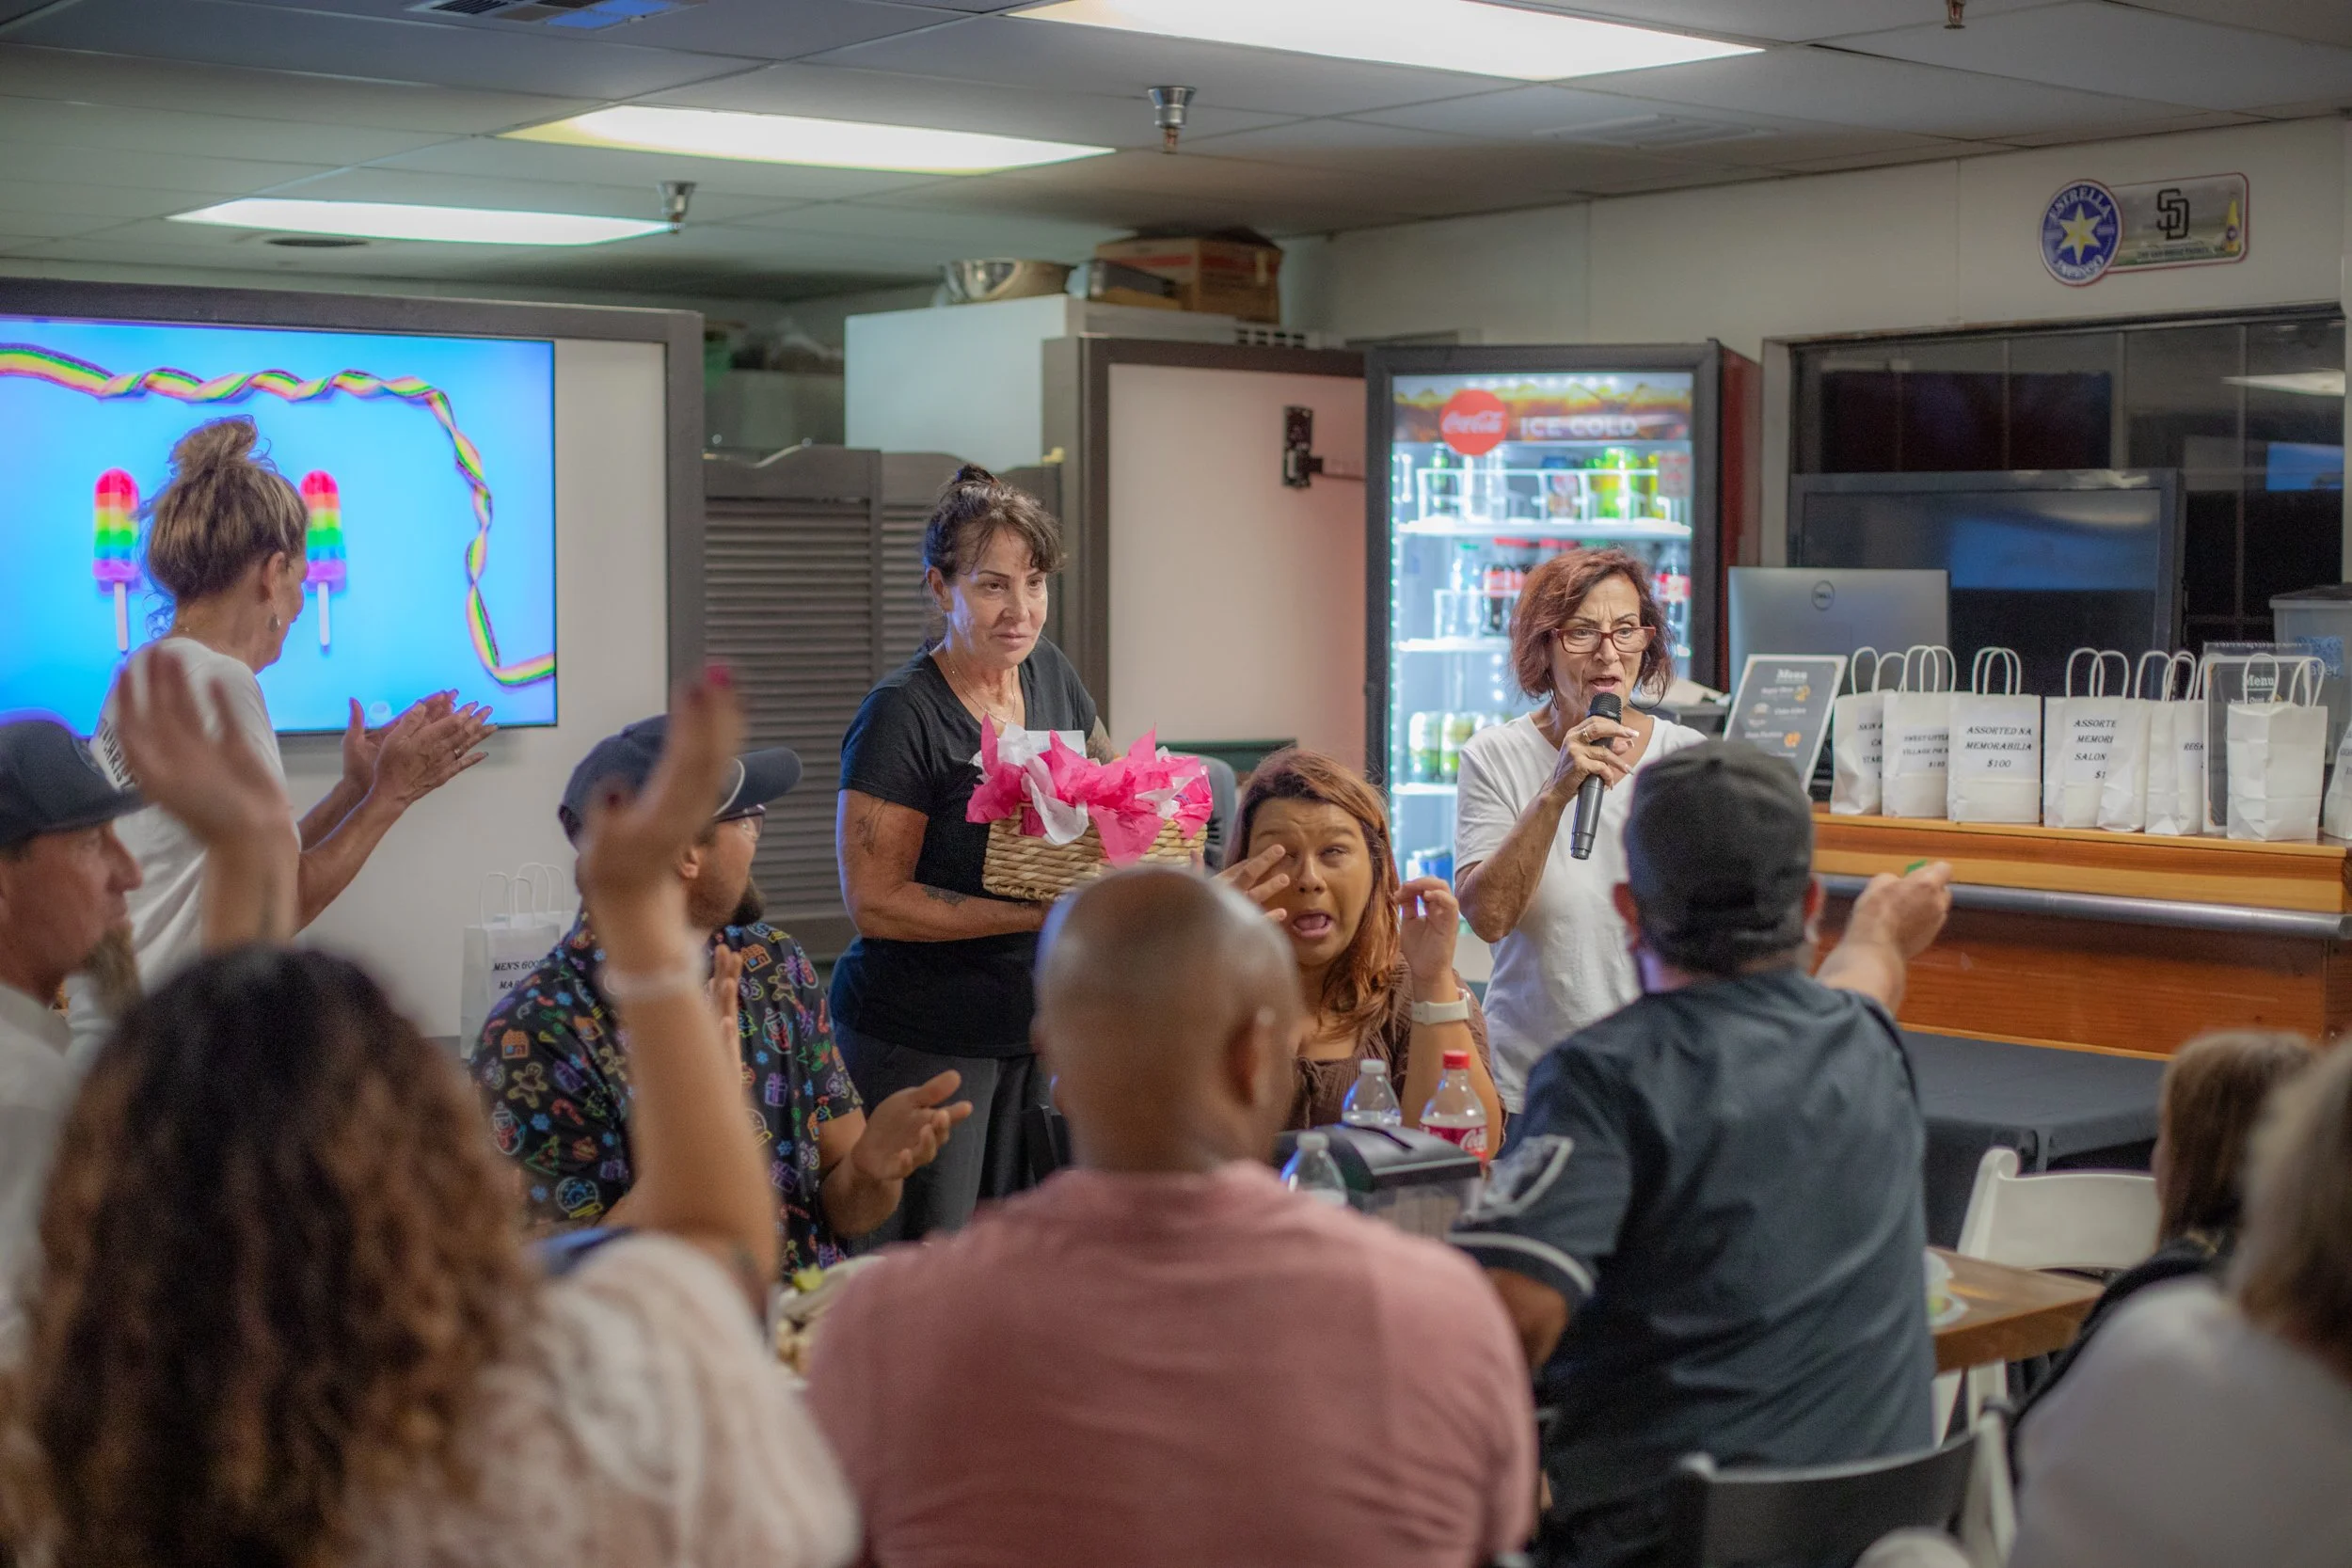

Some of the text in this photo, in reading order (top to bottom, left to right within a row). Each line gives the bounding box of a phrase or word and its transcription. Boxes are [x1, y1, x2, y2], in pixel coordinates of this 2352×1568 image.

[2049, 186, 2112, 221] ESTRELLA
[2156, 188, 2190, 241] SD
[1519, 415, 1638, 437] ICE COLD
[2074, 720, 2117, 728] ASSORTE
[1966, 725, 2032, 736] ASSORTED NA
[1964, 740, 2032, 752] MEMORABILIA
[2074, 752, 2107, 761] SALON
[1987, 759, 2011, 768] $100
[493, 961, 520, 972] MEN'S
